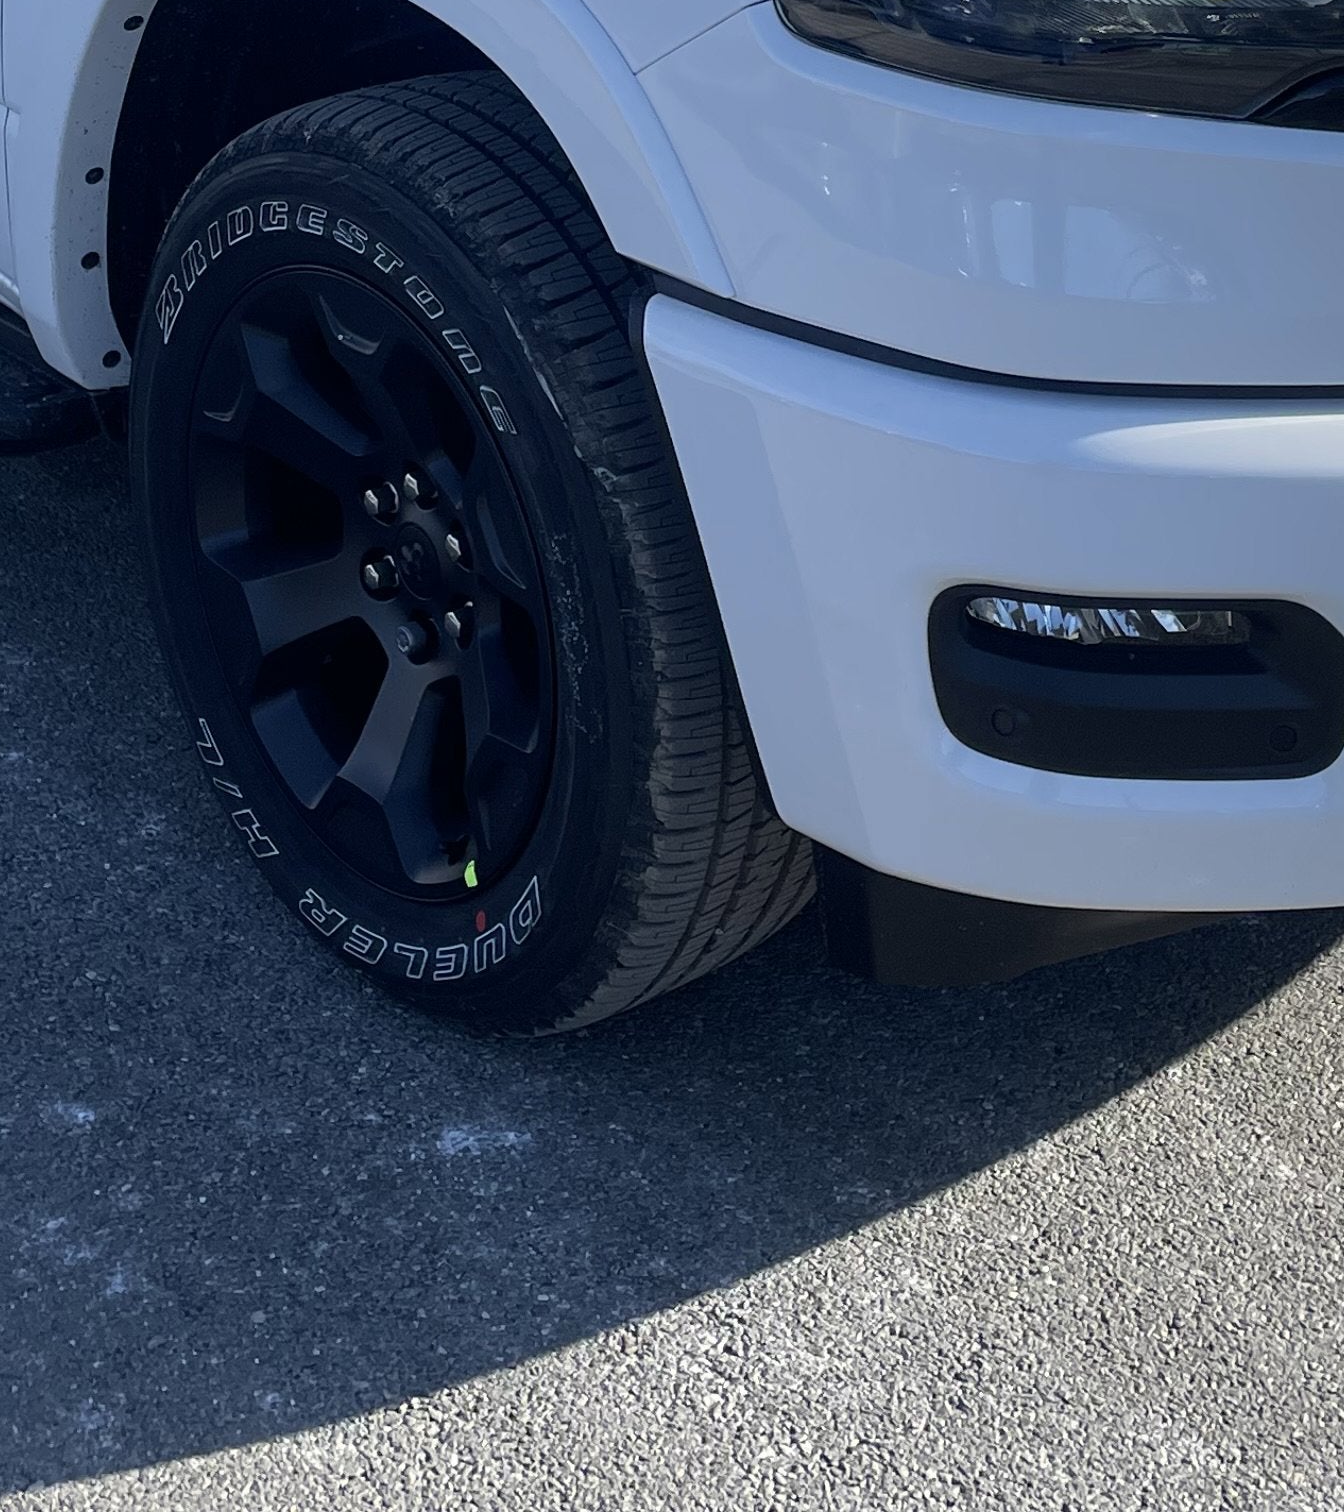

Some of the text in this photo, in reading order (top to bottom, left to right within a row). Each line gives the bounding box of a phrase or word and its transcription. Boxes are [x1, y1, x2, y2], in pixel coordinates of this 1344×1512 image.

[156, 200, 516, 435] BRIDGESTONE
[195, 717, 543, 981] DUELER H/L
